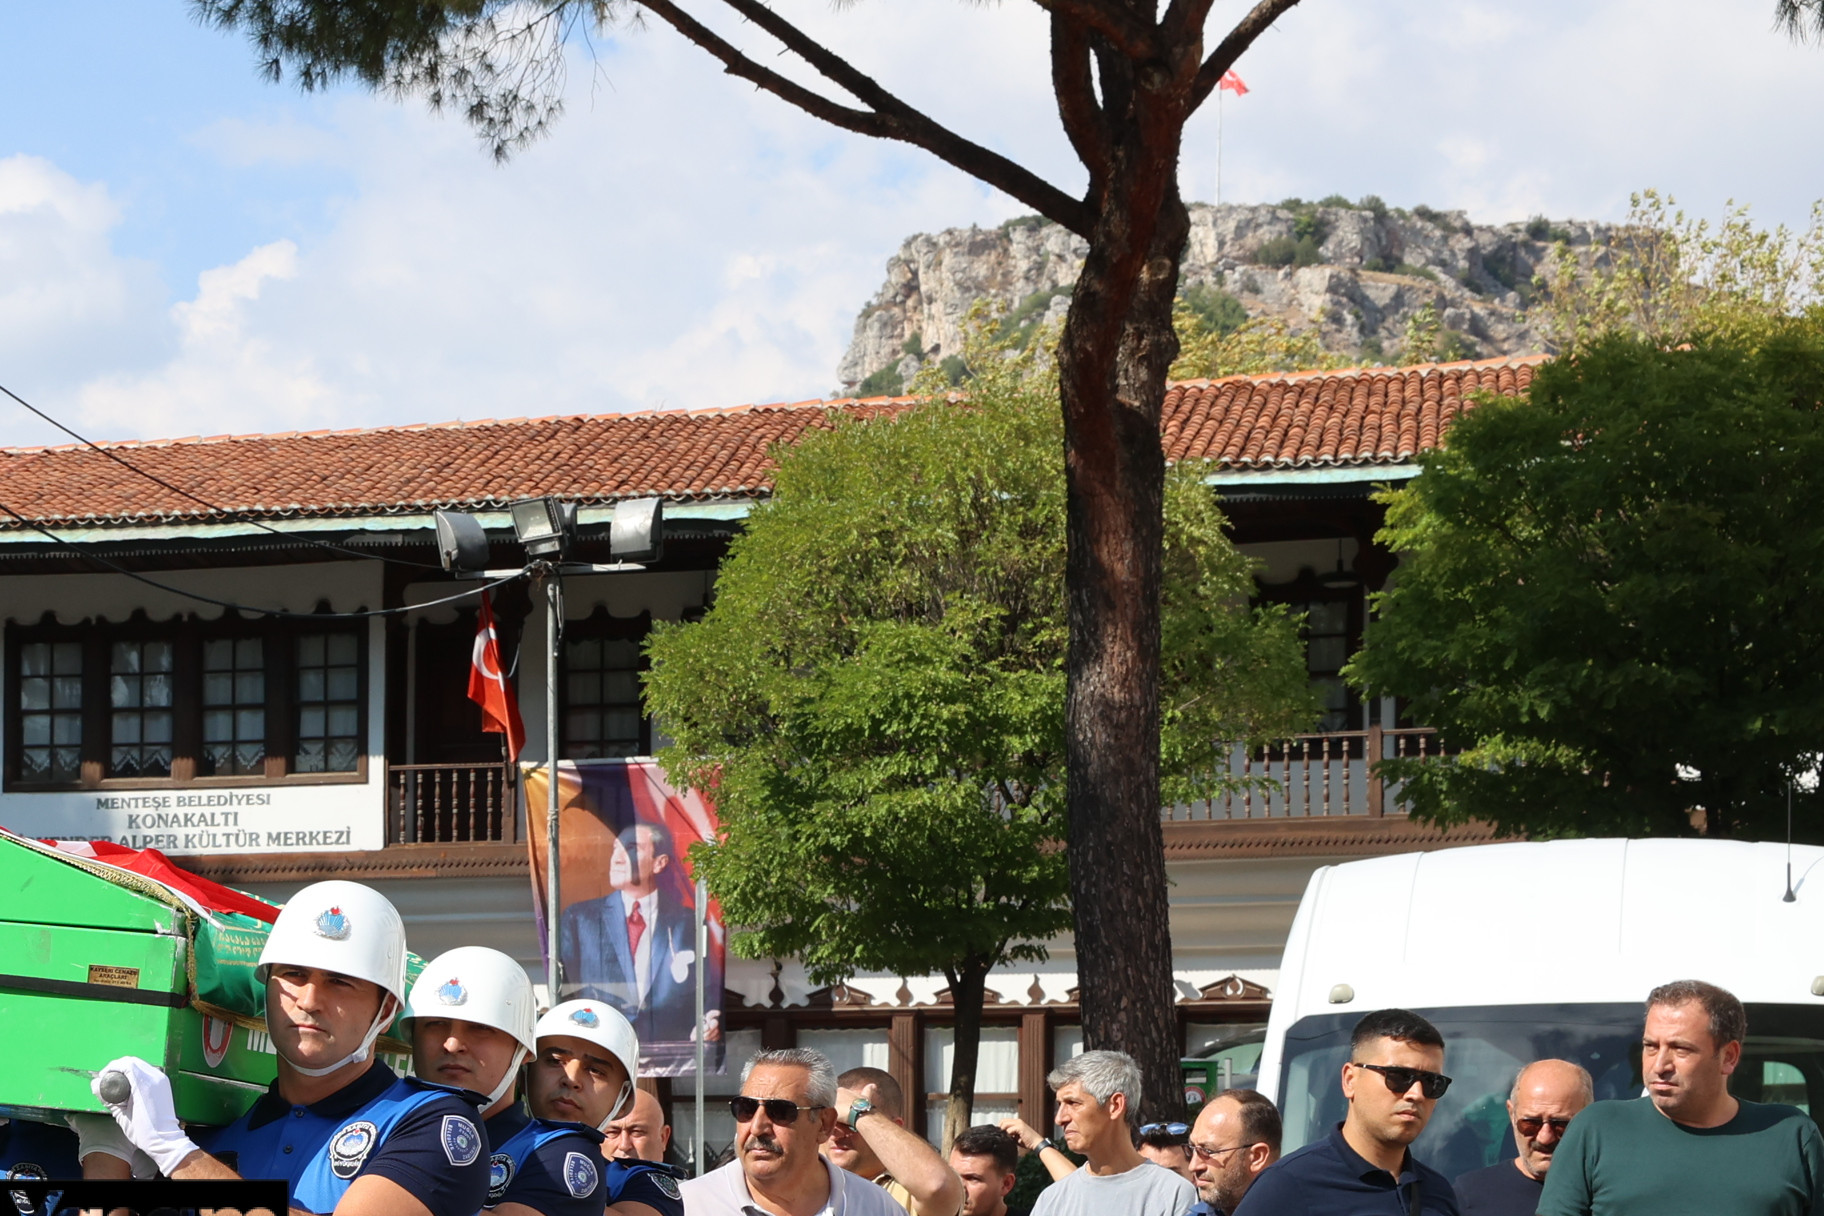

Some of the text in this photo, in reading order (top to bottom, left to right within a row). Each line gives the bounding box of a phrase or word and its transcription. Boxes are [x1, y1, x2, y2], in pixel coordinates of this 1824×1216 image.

[96, 796, 171, 811] MENTEŞE
[127, 811, 239, 829] KONAKALTI
[119, 834, 178, 850] ALPER
[184, 829, 261, 849] KÜLTÜR
[266, 826, 351, 847] MERKEZİ
